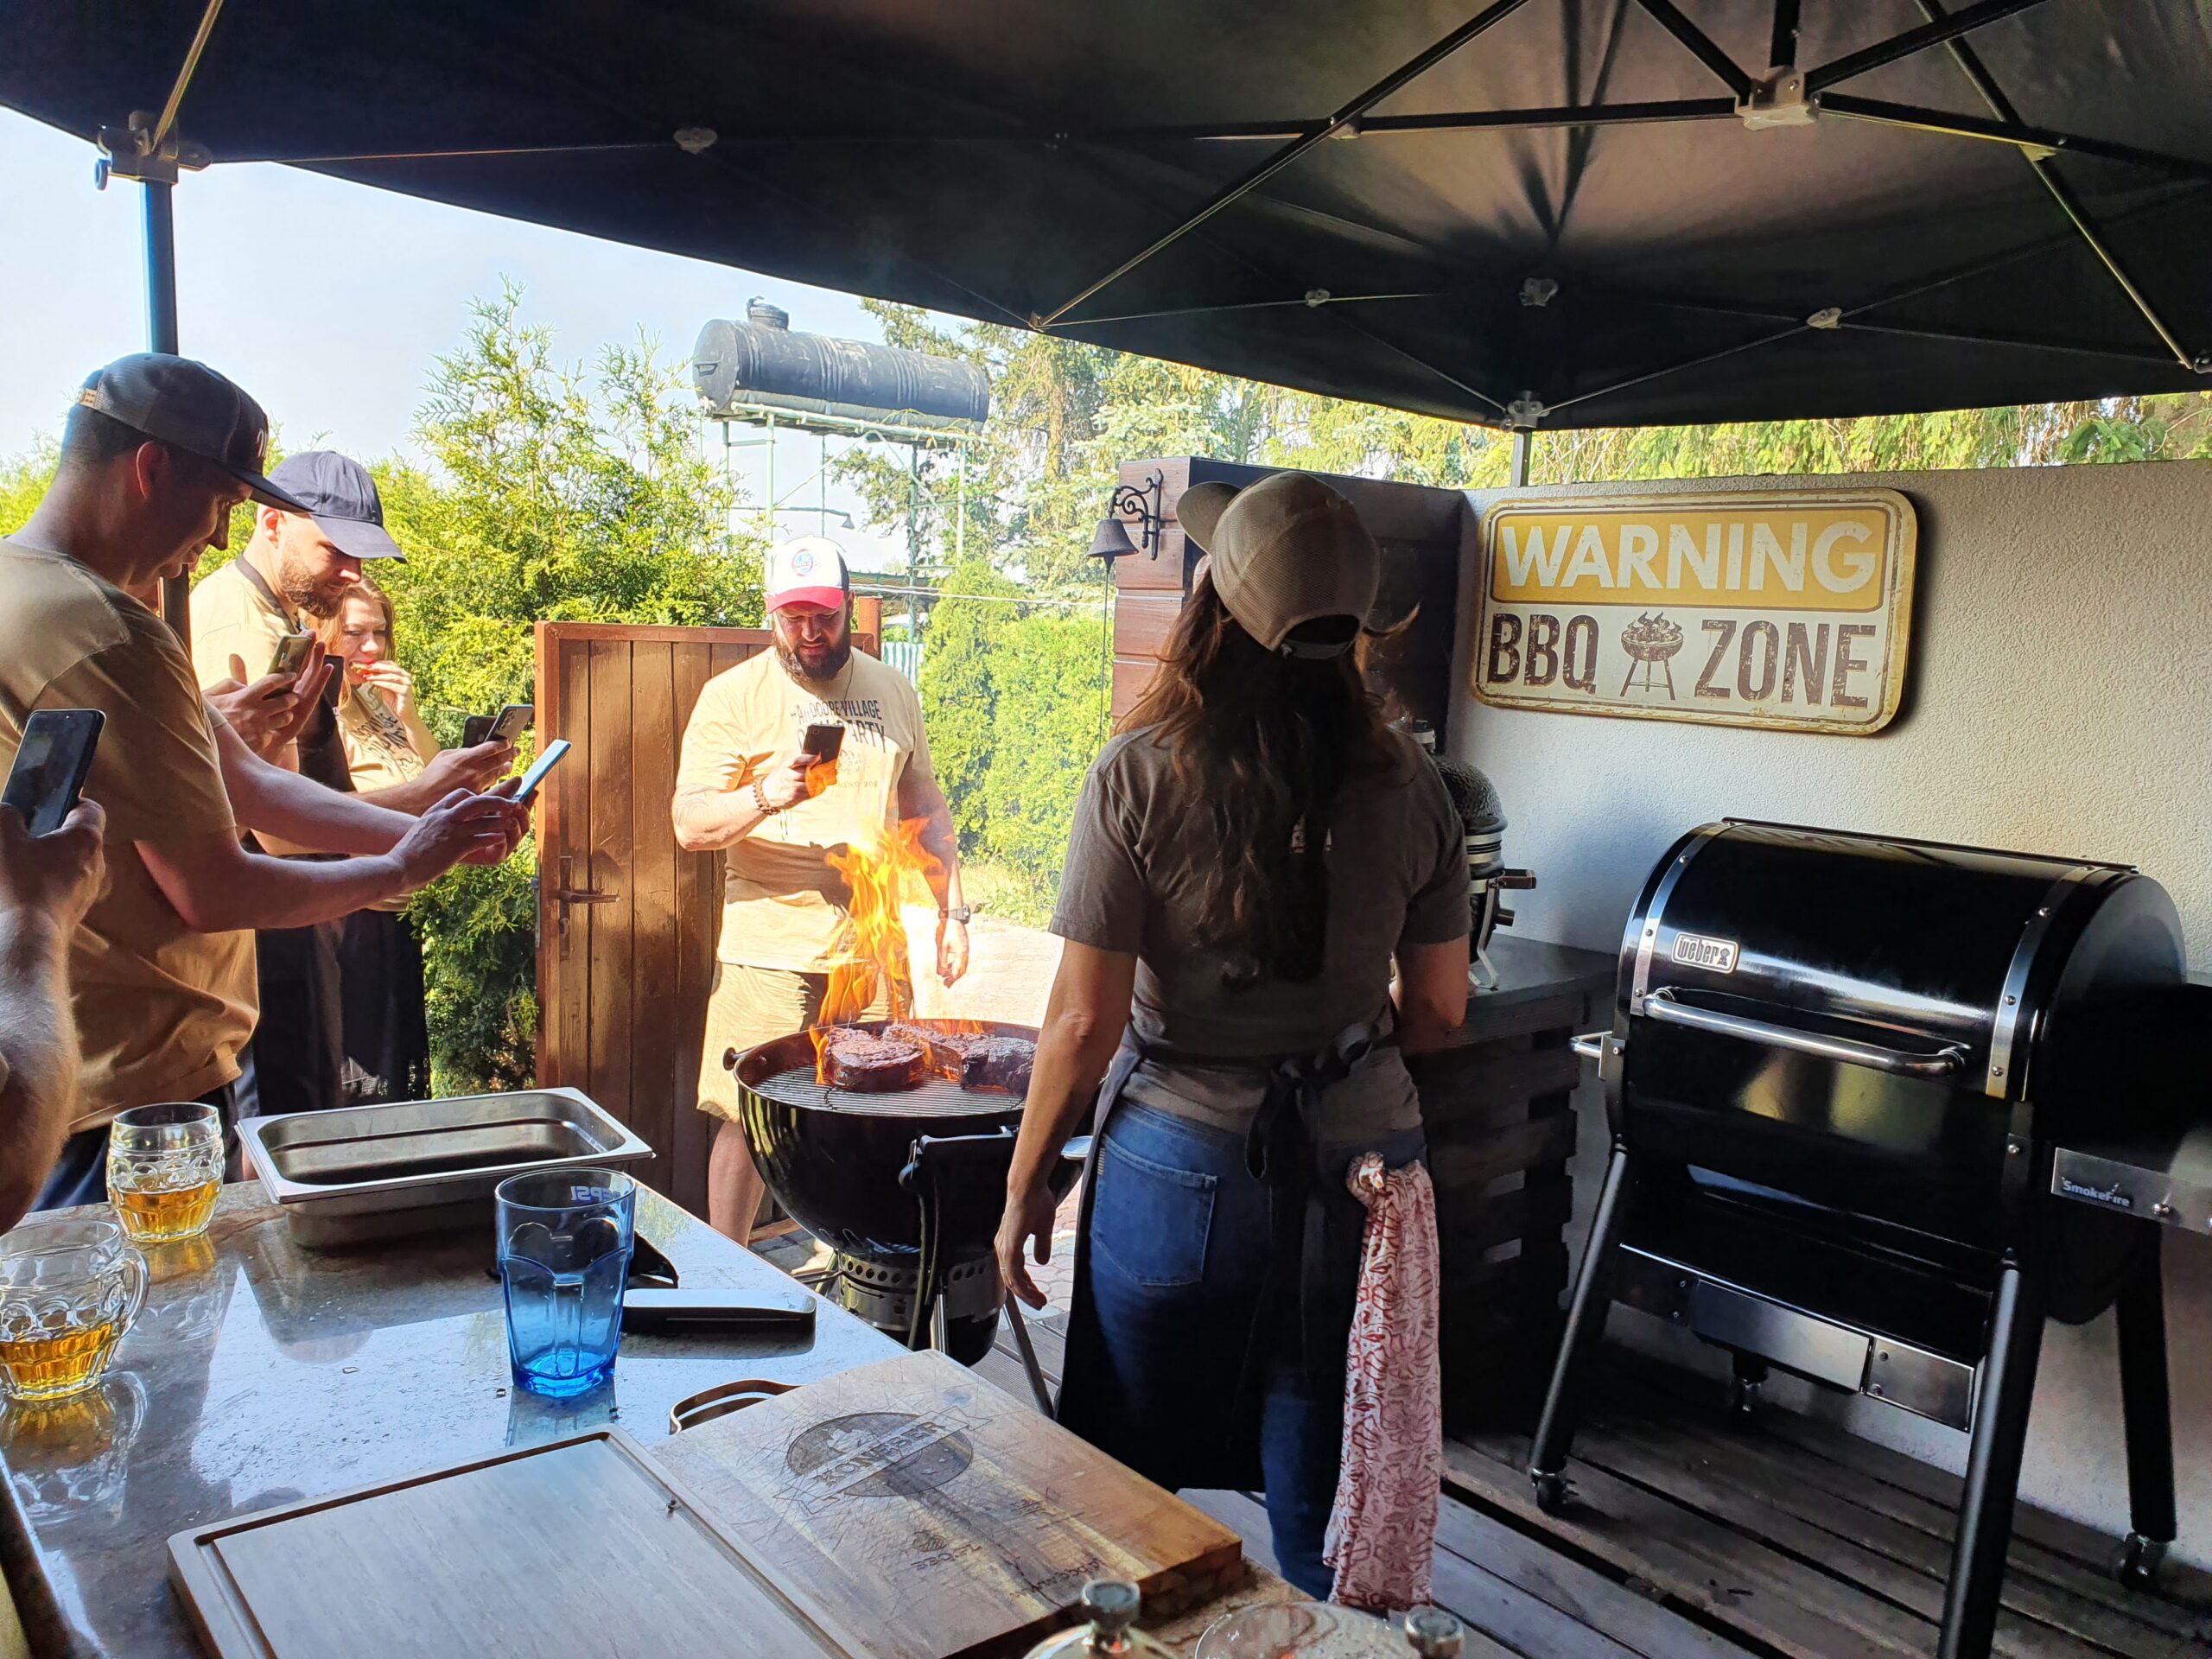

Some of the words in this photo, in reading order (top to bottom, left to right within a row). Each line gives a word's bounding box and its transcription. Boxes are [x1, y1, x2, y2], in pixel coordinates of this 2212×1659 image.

[1502, 520, 1878, 594] WARNING
[1486, 612, 1600, 696] BBQ
[1694, 619, 1877, 710] ZONE
[841, 699, 882, 720] VILLAGE
[836, 720, 885, 753] ARTY
[1677, 937, 1719, 964] weber
[2063, 1180, 2130, 1206] SmokeFire
